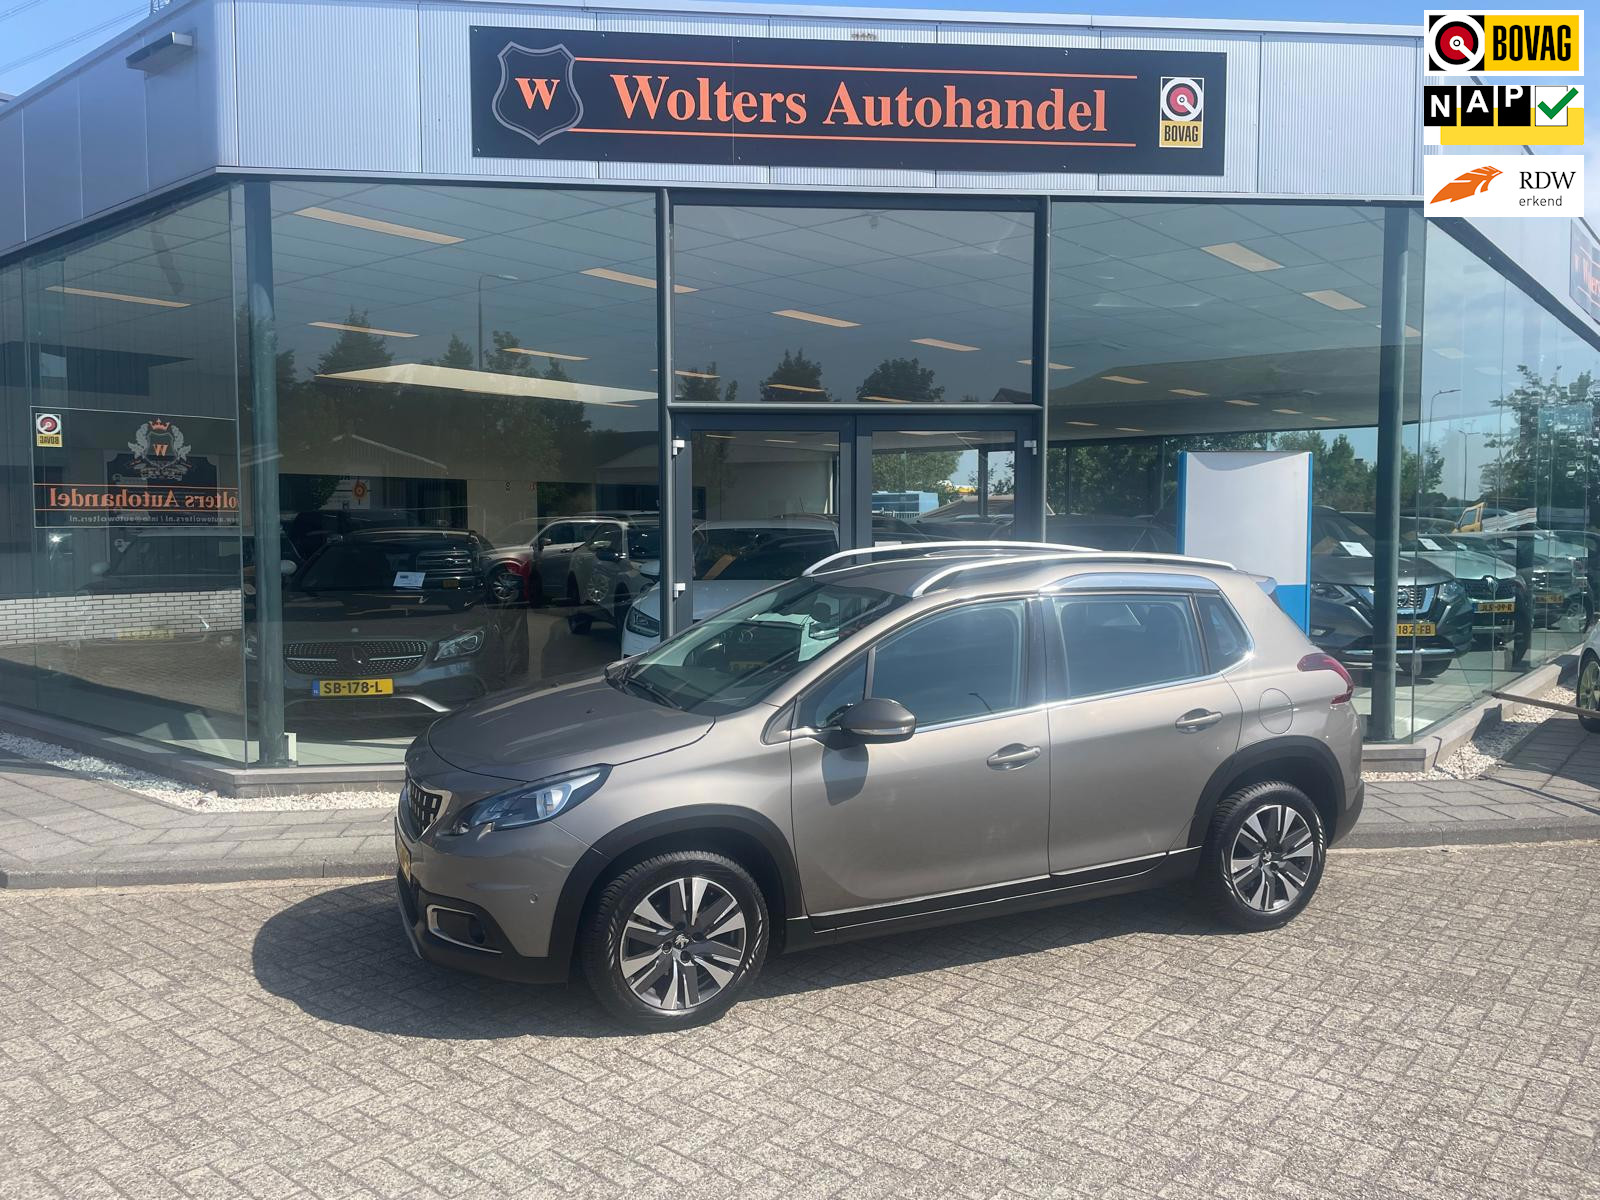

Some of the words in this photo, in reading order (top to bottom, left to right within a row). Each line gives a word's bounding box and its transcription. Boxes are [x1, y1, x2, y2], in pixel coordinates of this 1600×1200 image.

[514, 78, 560, 110] W
[610, 74, 807, 124] Wolters
[822, 81, 1107, 131] Autohandel
[1164, 125, 1198, 142] BOVAG
[323, 681, 383, 694] SB-178-L
